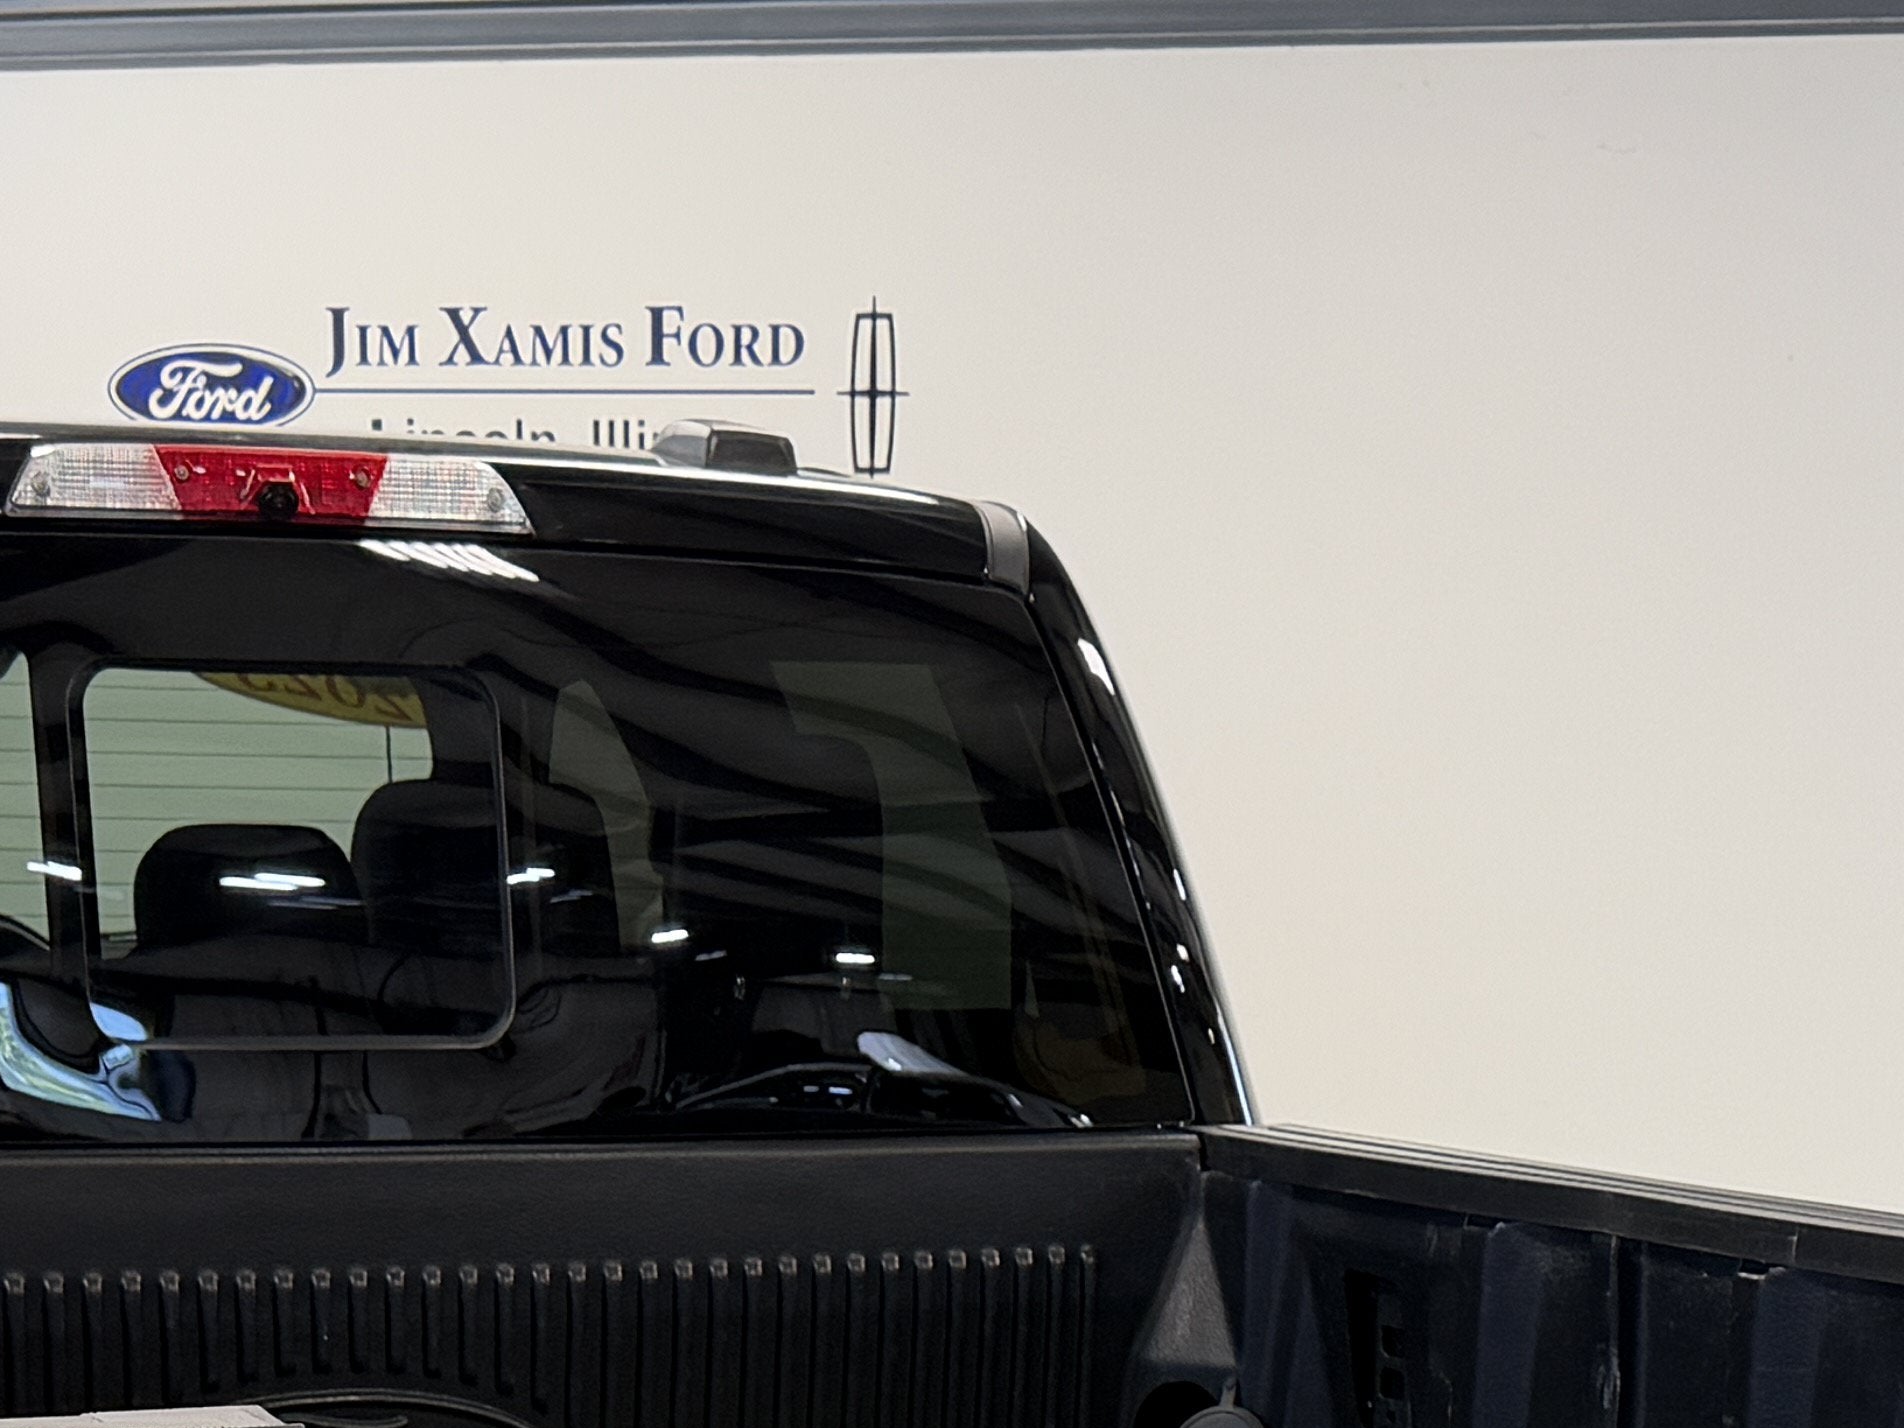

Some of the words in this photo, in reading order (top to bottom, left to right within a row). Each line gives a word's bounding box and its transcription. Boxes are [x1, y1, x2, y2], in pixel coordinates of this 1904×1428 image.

[323, 305, 419, 378] JIM
[437, 304, 625, 369] XAMIS
[644, 305, 807, 369] FORD
[147, 360, 272, 423] Ford
